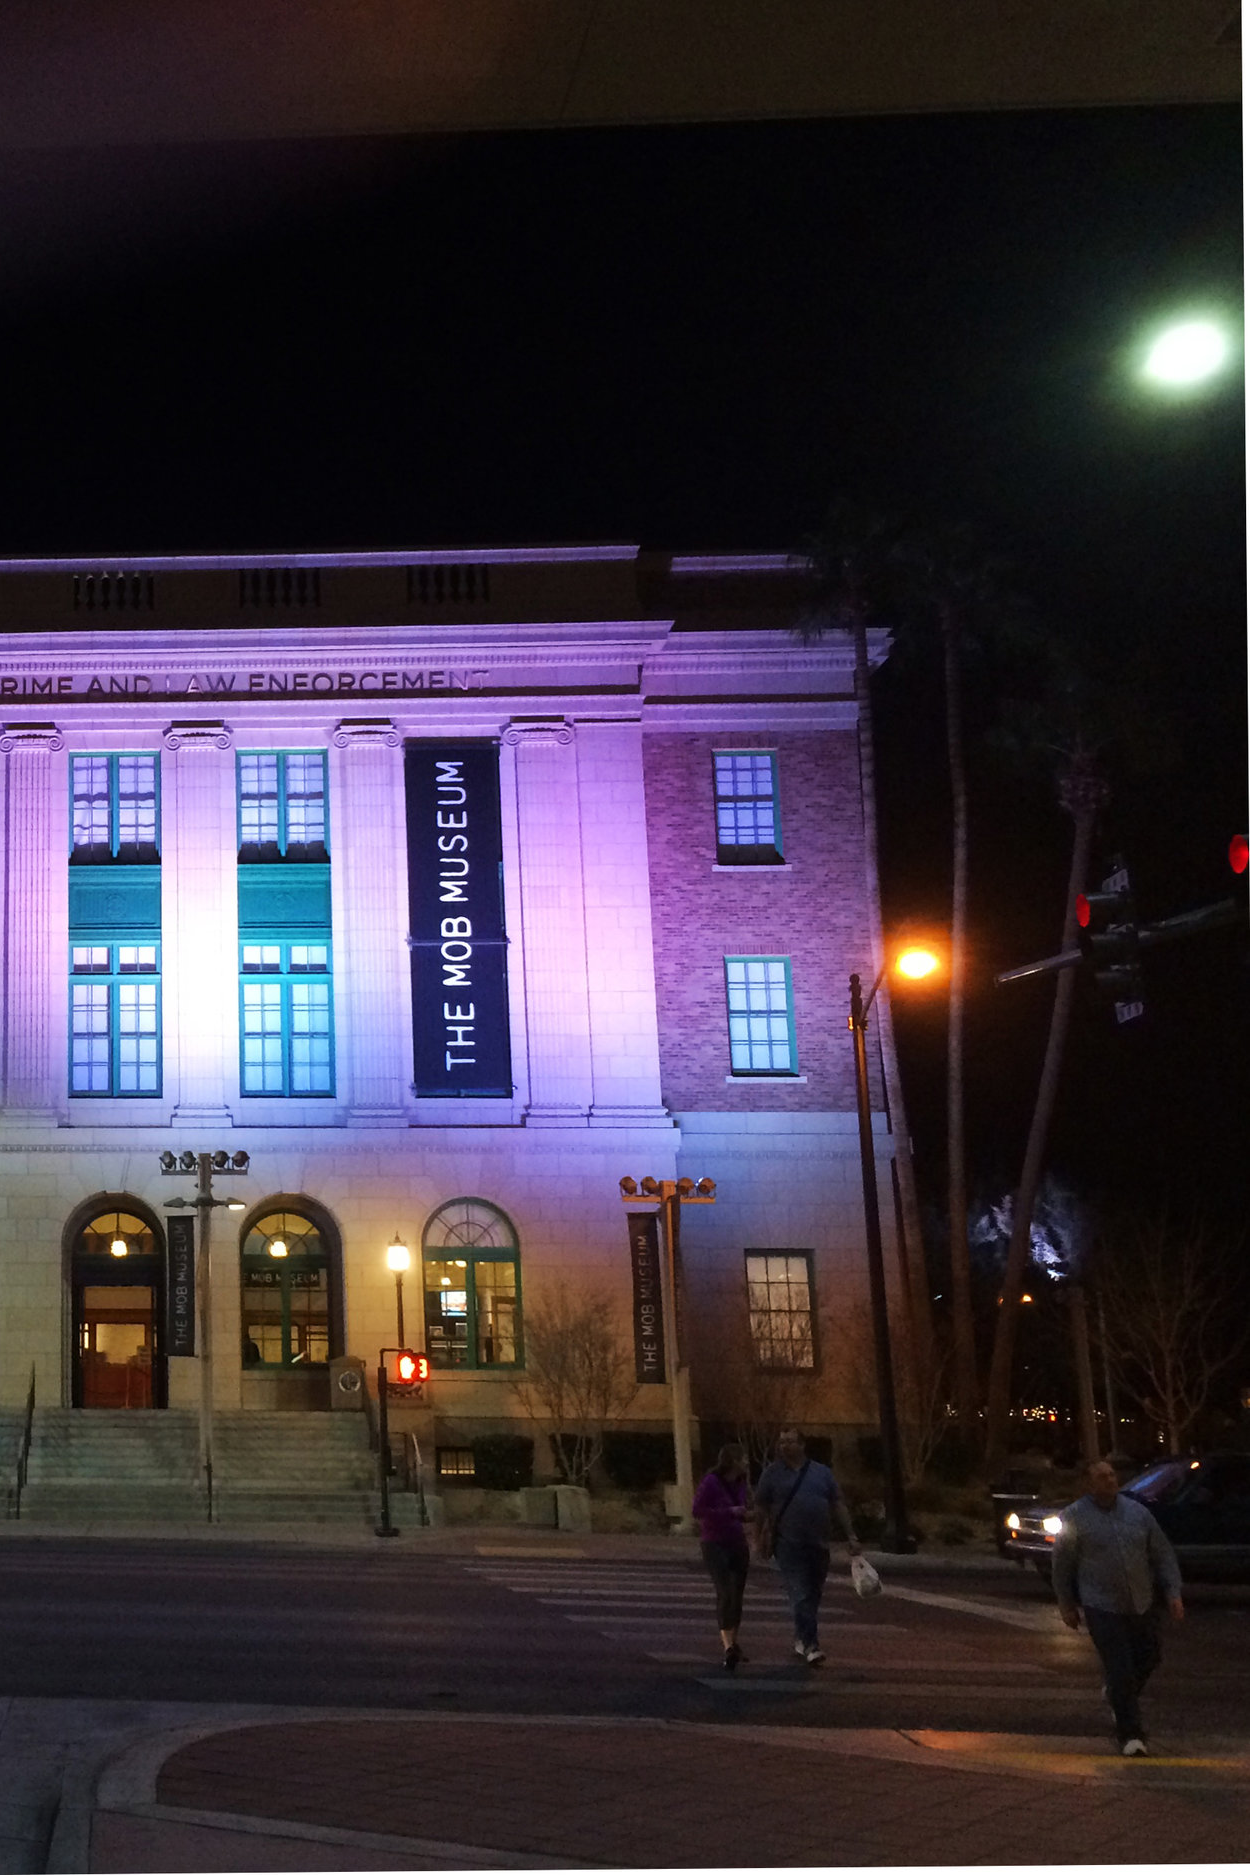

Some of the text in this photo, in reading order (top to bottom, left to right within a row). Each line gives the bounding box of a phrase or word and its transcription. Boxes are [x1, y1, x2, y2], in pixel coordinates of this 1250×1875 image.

[86, 675, 151, 696] AND
[165, 674, 237, 694] LAW
[250, 670, 489, 692] ENFORCEMENT
[435, 760, 477, 1071] THE MOB MUSEUM
[174, 1224, 188, 1347] THE MOB MUSEUM
[641, 1303, 656, 1336] MOB
[418, 1358, 428, 1379] 3
[642, 1343, 657, 1372] THE
